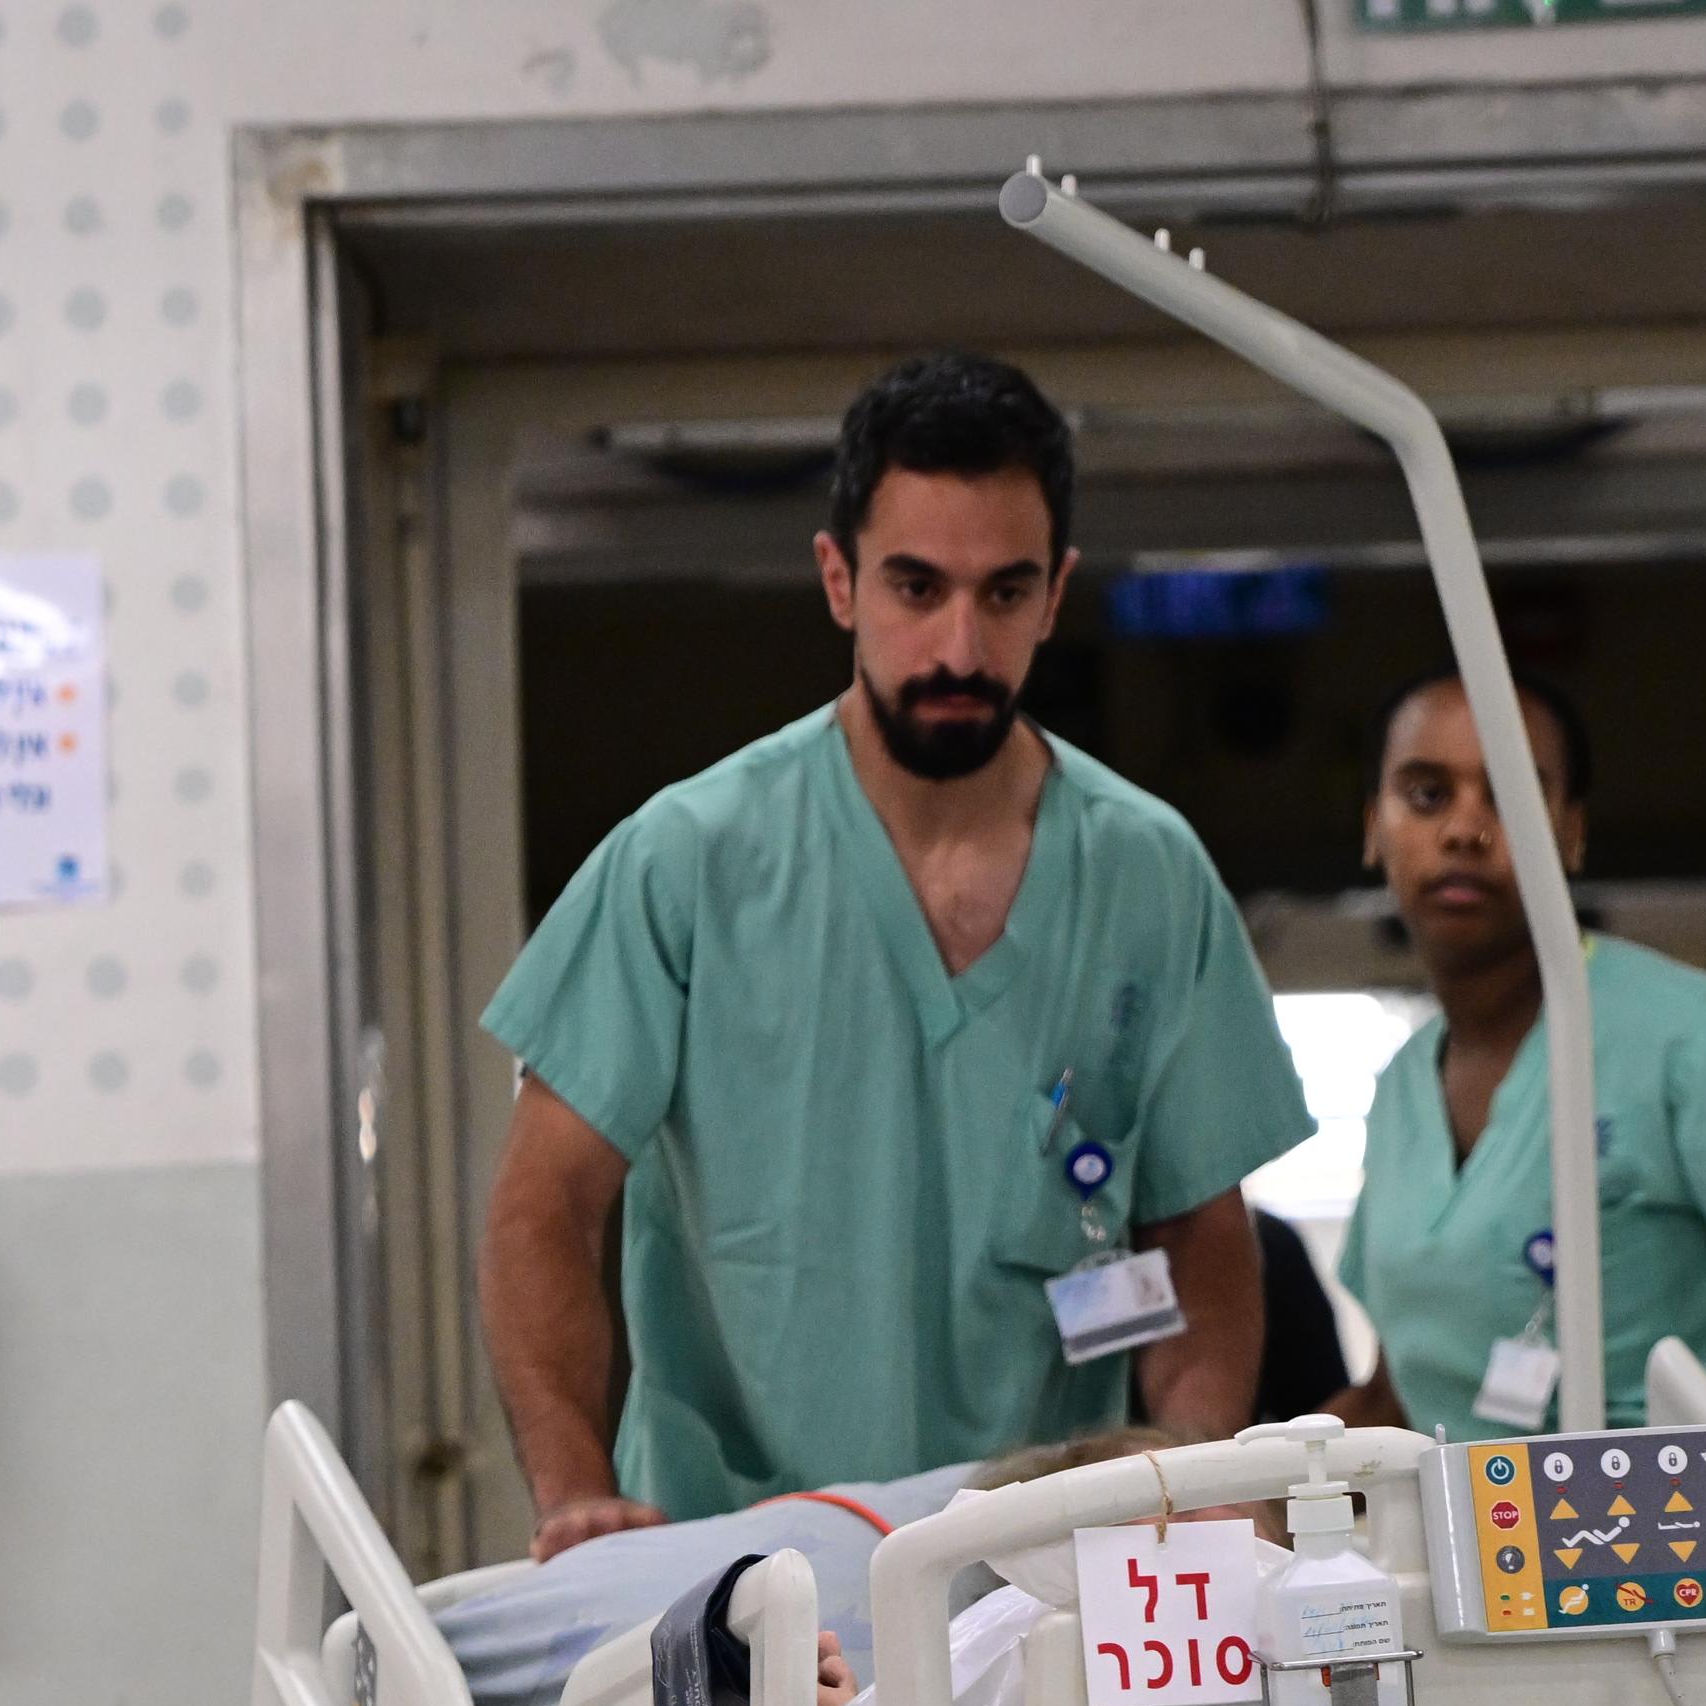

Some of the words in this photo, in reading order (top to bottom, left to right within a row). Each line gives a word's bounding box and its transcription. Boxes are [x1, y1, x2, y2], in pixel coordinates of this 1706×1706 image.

[1493, 1510, 1518, 1520] STOP
[1127, 1558, 1210, 1623] דל
[1678, 1588, 1697, 1597] CPR
[1365, 1601, 1387, 1610] תאריך
[1623, 1598, 1636, 1606] TR
[1368, 1620, 1389, 1628] תאריך
[1097, 1635, 1253, 1690] סוכר
